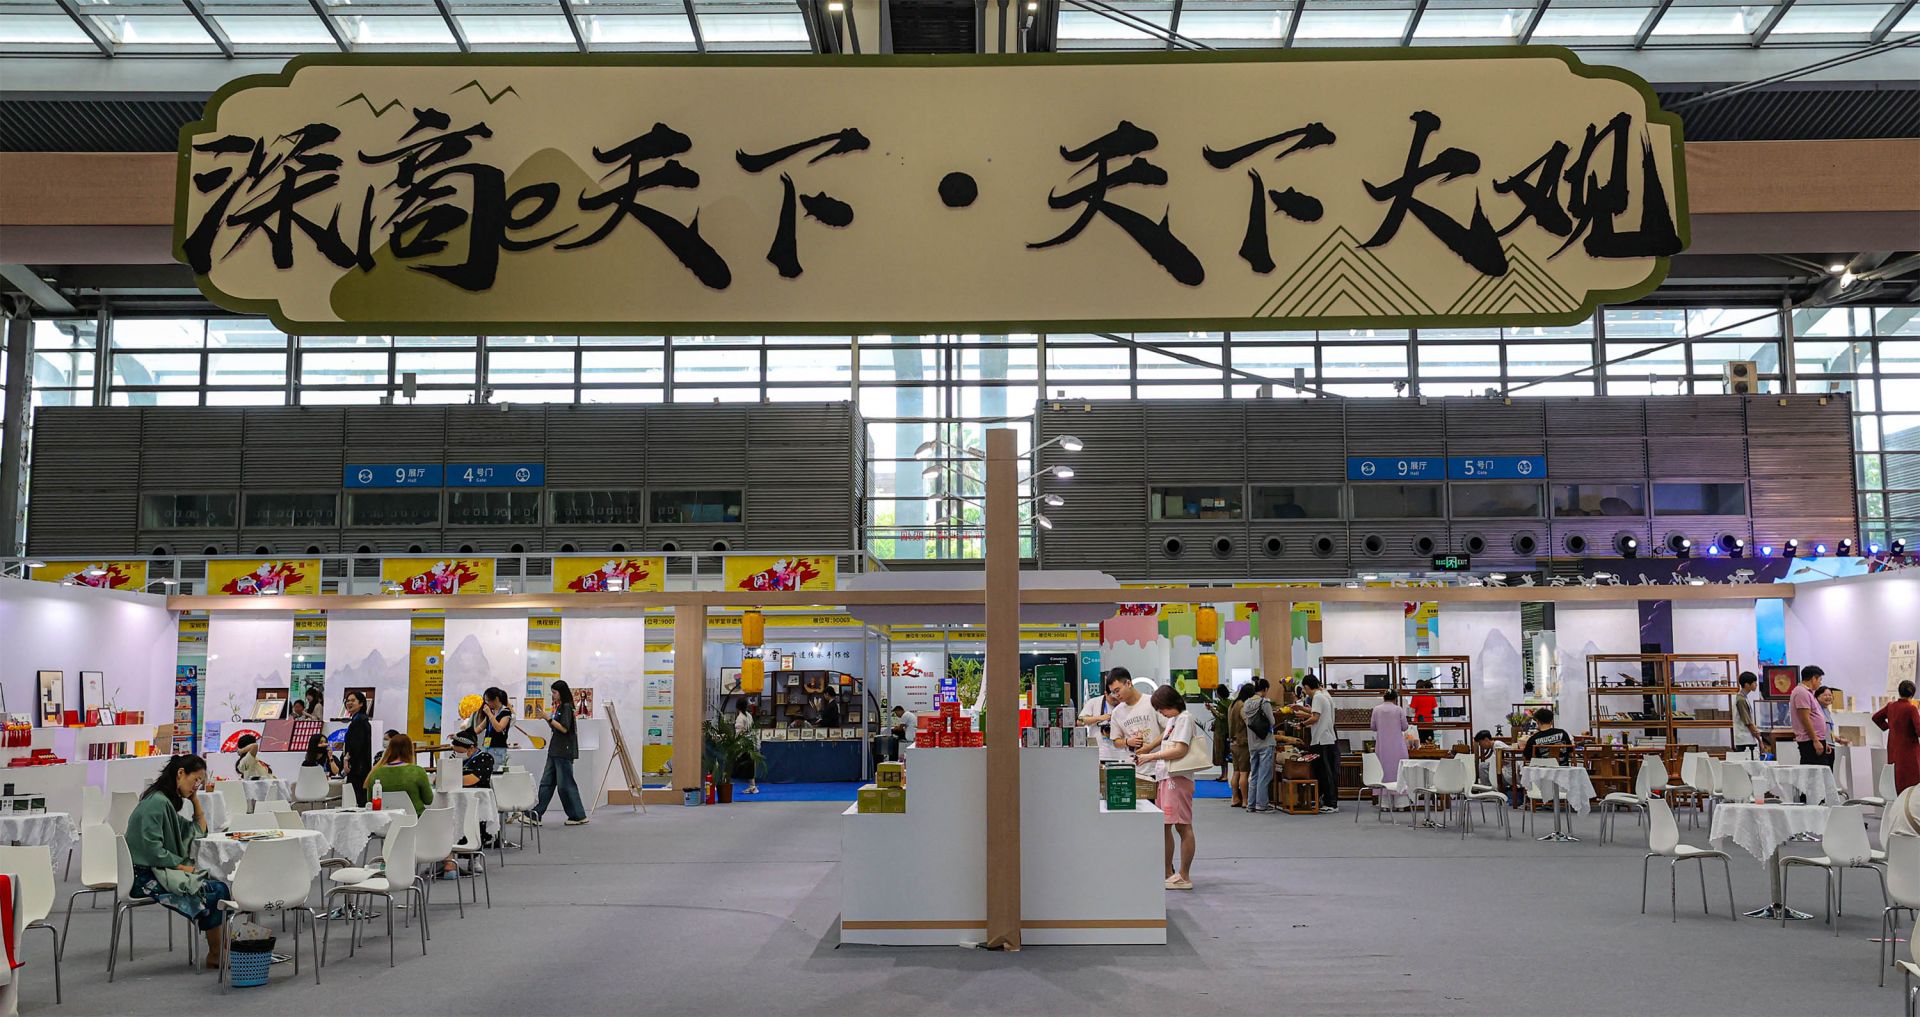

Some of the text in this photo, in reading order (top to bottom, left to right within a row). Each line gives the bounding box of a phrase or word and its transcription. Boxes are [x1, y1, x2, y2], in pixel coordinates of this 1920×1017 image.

[1397, 461, 1427, 475] 9 展厅
[1464, 461, 1494, 475] 5 号门
[395, 468, 425, 483] 9 展厅
[463, 468, 493, 483] 4 号门
[1123, 715, 1151, 727] ORIGINAL
